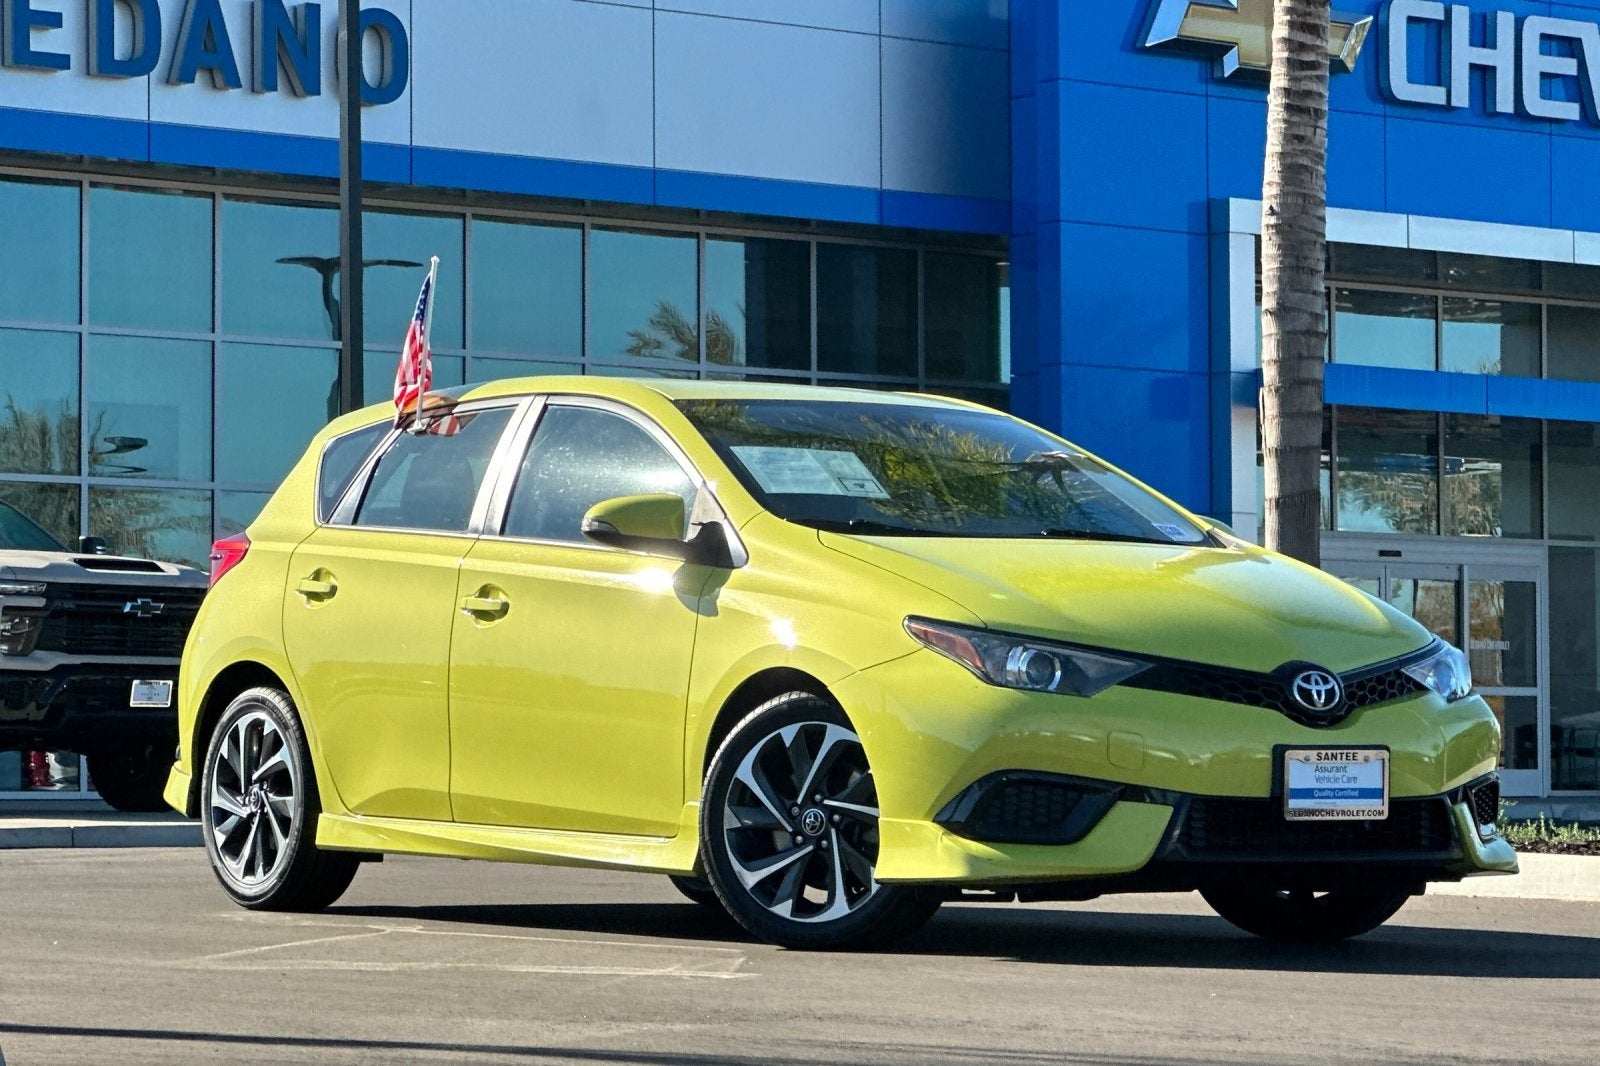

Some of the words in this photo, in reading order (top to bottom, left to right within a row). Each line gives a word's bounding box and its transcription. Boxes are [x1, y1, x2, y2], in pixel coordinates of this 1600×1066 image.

[3, 0, 408, 105] EDANO
[1316, 752, 1358, 761] SANTEE
[1314, 765, 1347, 773] Assurant
[1315, 775, 1340, 784] Vehicle
[1341, 775, 1358, 784] Care
[1313, 790, 1334, 798] Quality
[1334, 789, 1359, 797] Certified
